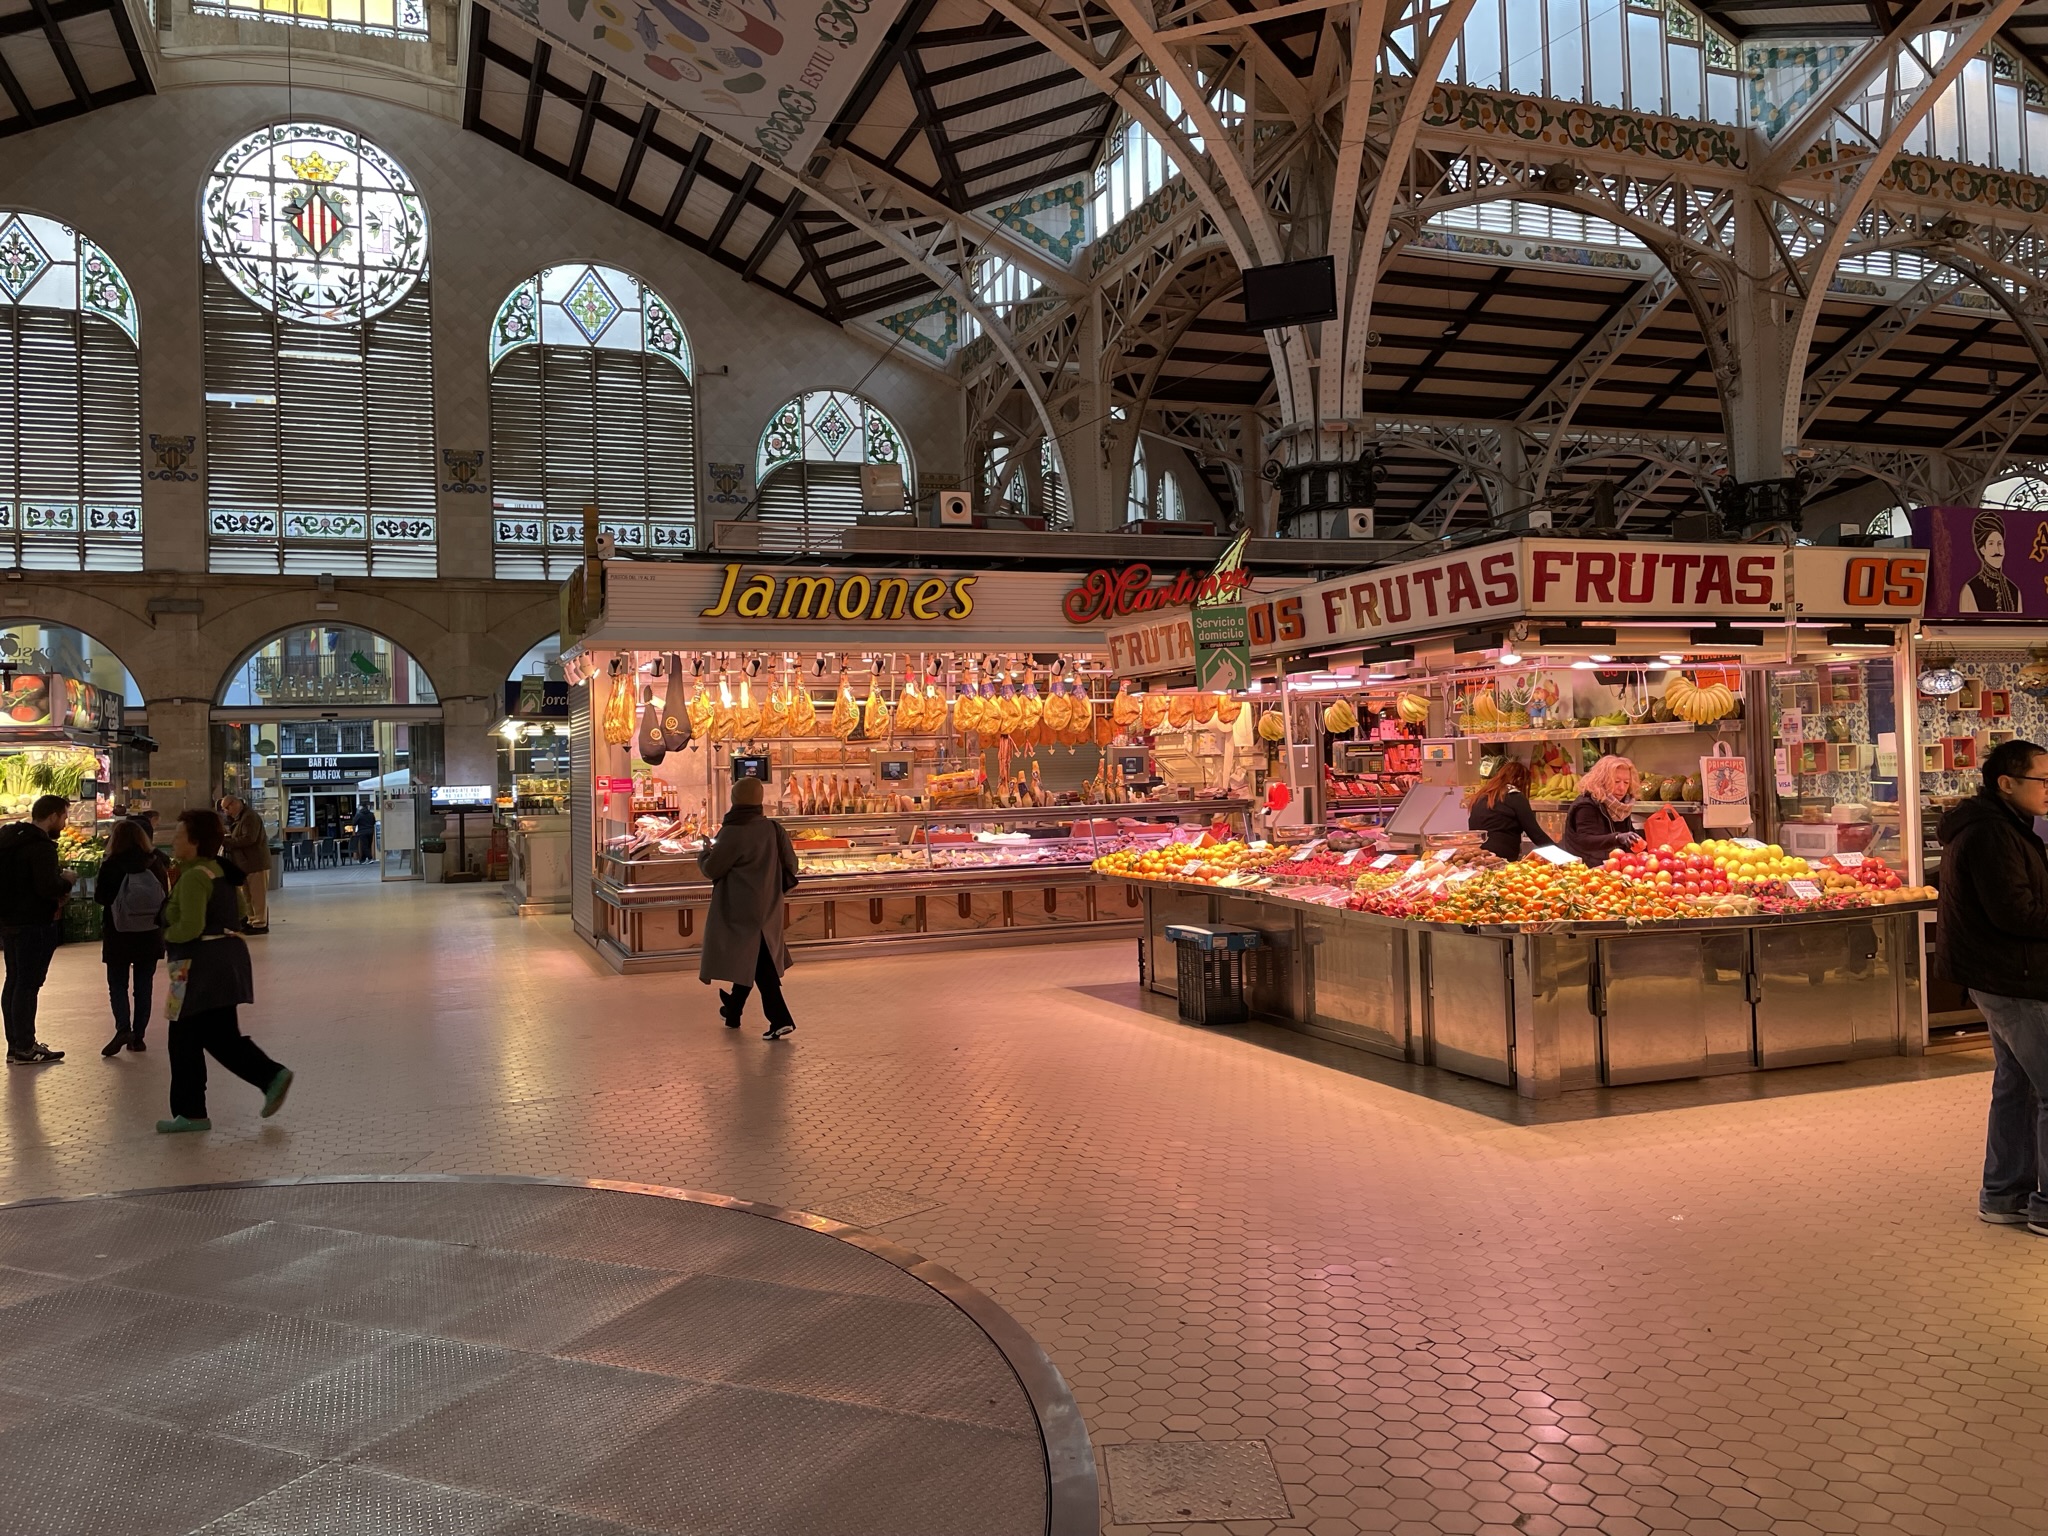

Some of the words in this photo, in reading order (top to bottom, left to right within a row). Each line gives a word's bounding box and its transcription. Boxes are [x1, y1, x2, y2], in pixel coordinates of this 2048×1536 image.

[799, 45, 836, 90] ESTIU
[699, 563, 979, 621] Jamones
[1322, 552, 1519, 634] FRUTAS
[1532, 550, 1776, 605] FRUTAS
[1844, 557, 1927, 606] OS
[1196, 616, 1236, 628] Servicio
[1238, 617, 1244, 626] a
[1198, 628, 1244, 641] domicilio
[1248, 596, 1306, 646] OS
[1109, 620, 1195, 670] FRUTA
[308, 757, 322, 768] BAR
[324, 757, 338, 768] FOX
[312, 769, 327, 780] BAR
[327, 769, 341, 780] FOX
[1708, 760, 1744, 772] PRINCIPIS
